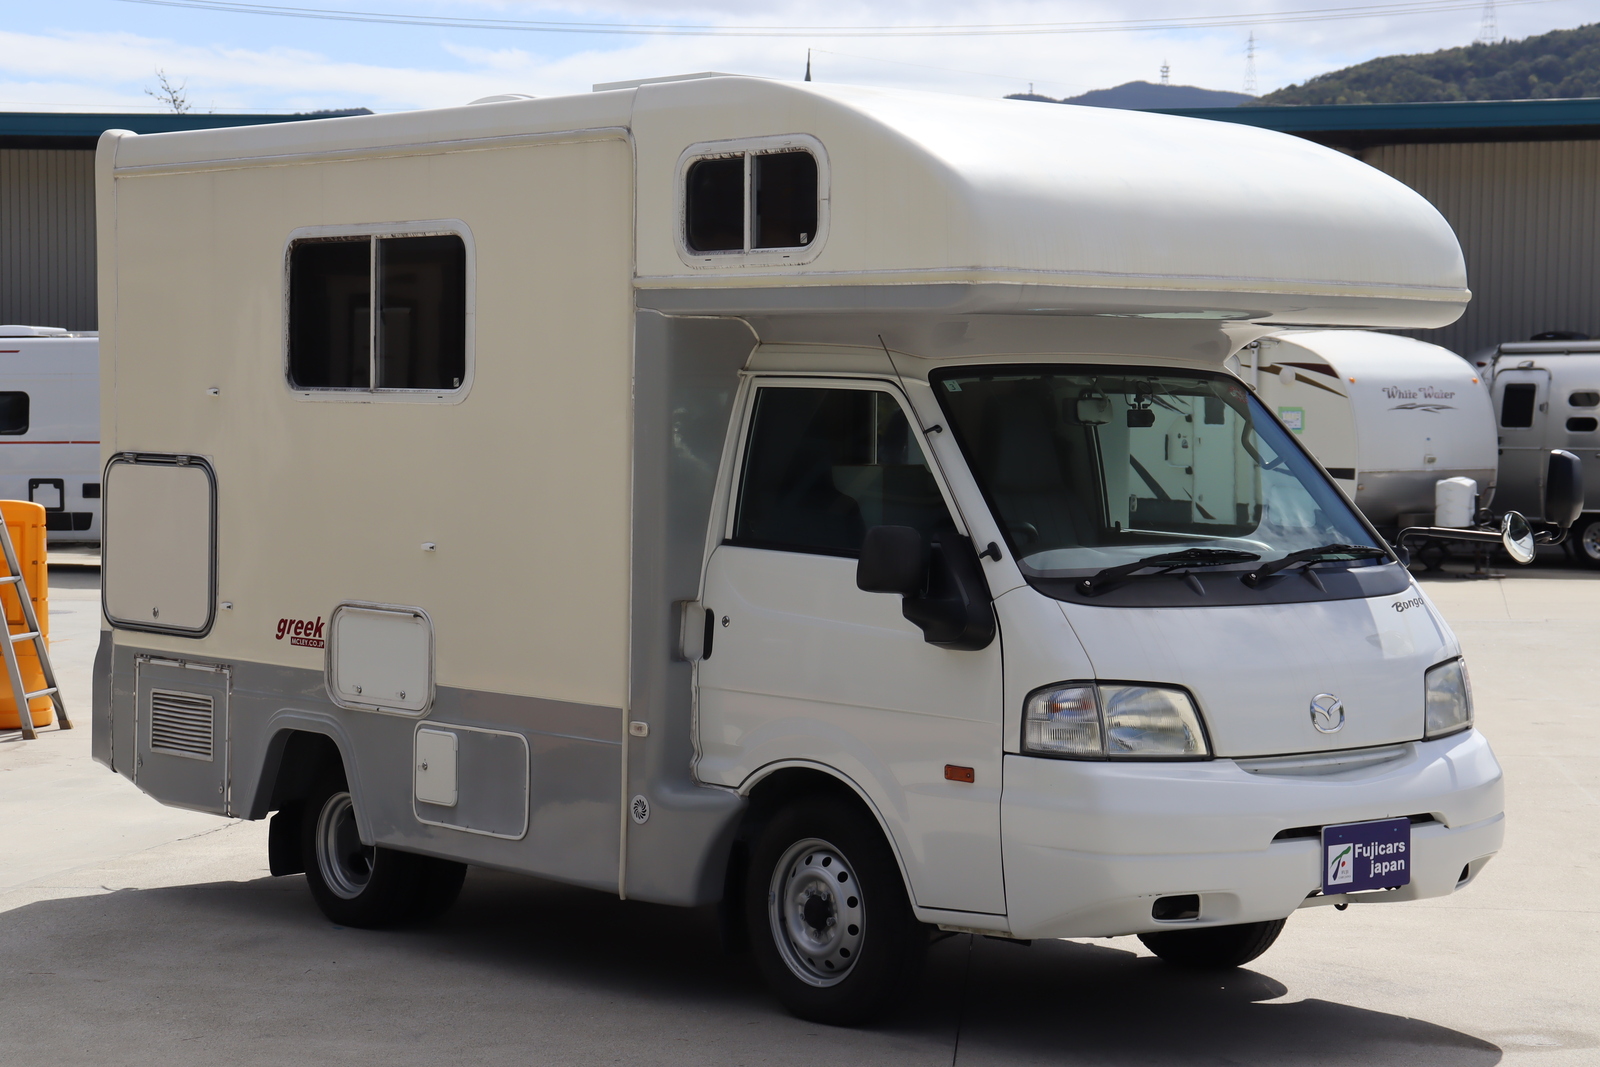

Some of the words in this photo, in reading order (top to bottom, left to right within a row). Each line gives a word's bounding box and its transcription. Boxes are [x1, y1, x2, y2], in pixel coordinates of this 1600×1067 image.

[1382, 386, 1418, 399] White
[1418, 386, 1455, 399] Water
[1391, 598, 1424, 613] Bongo
[275, 616, 325, 640] greek
[1354, 841, 1405, 860] Fujicars
[1369, 859, 1405, 878] japan
